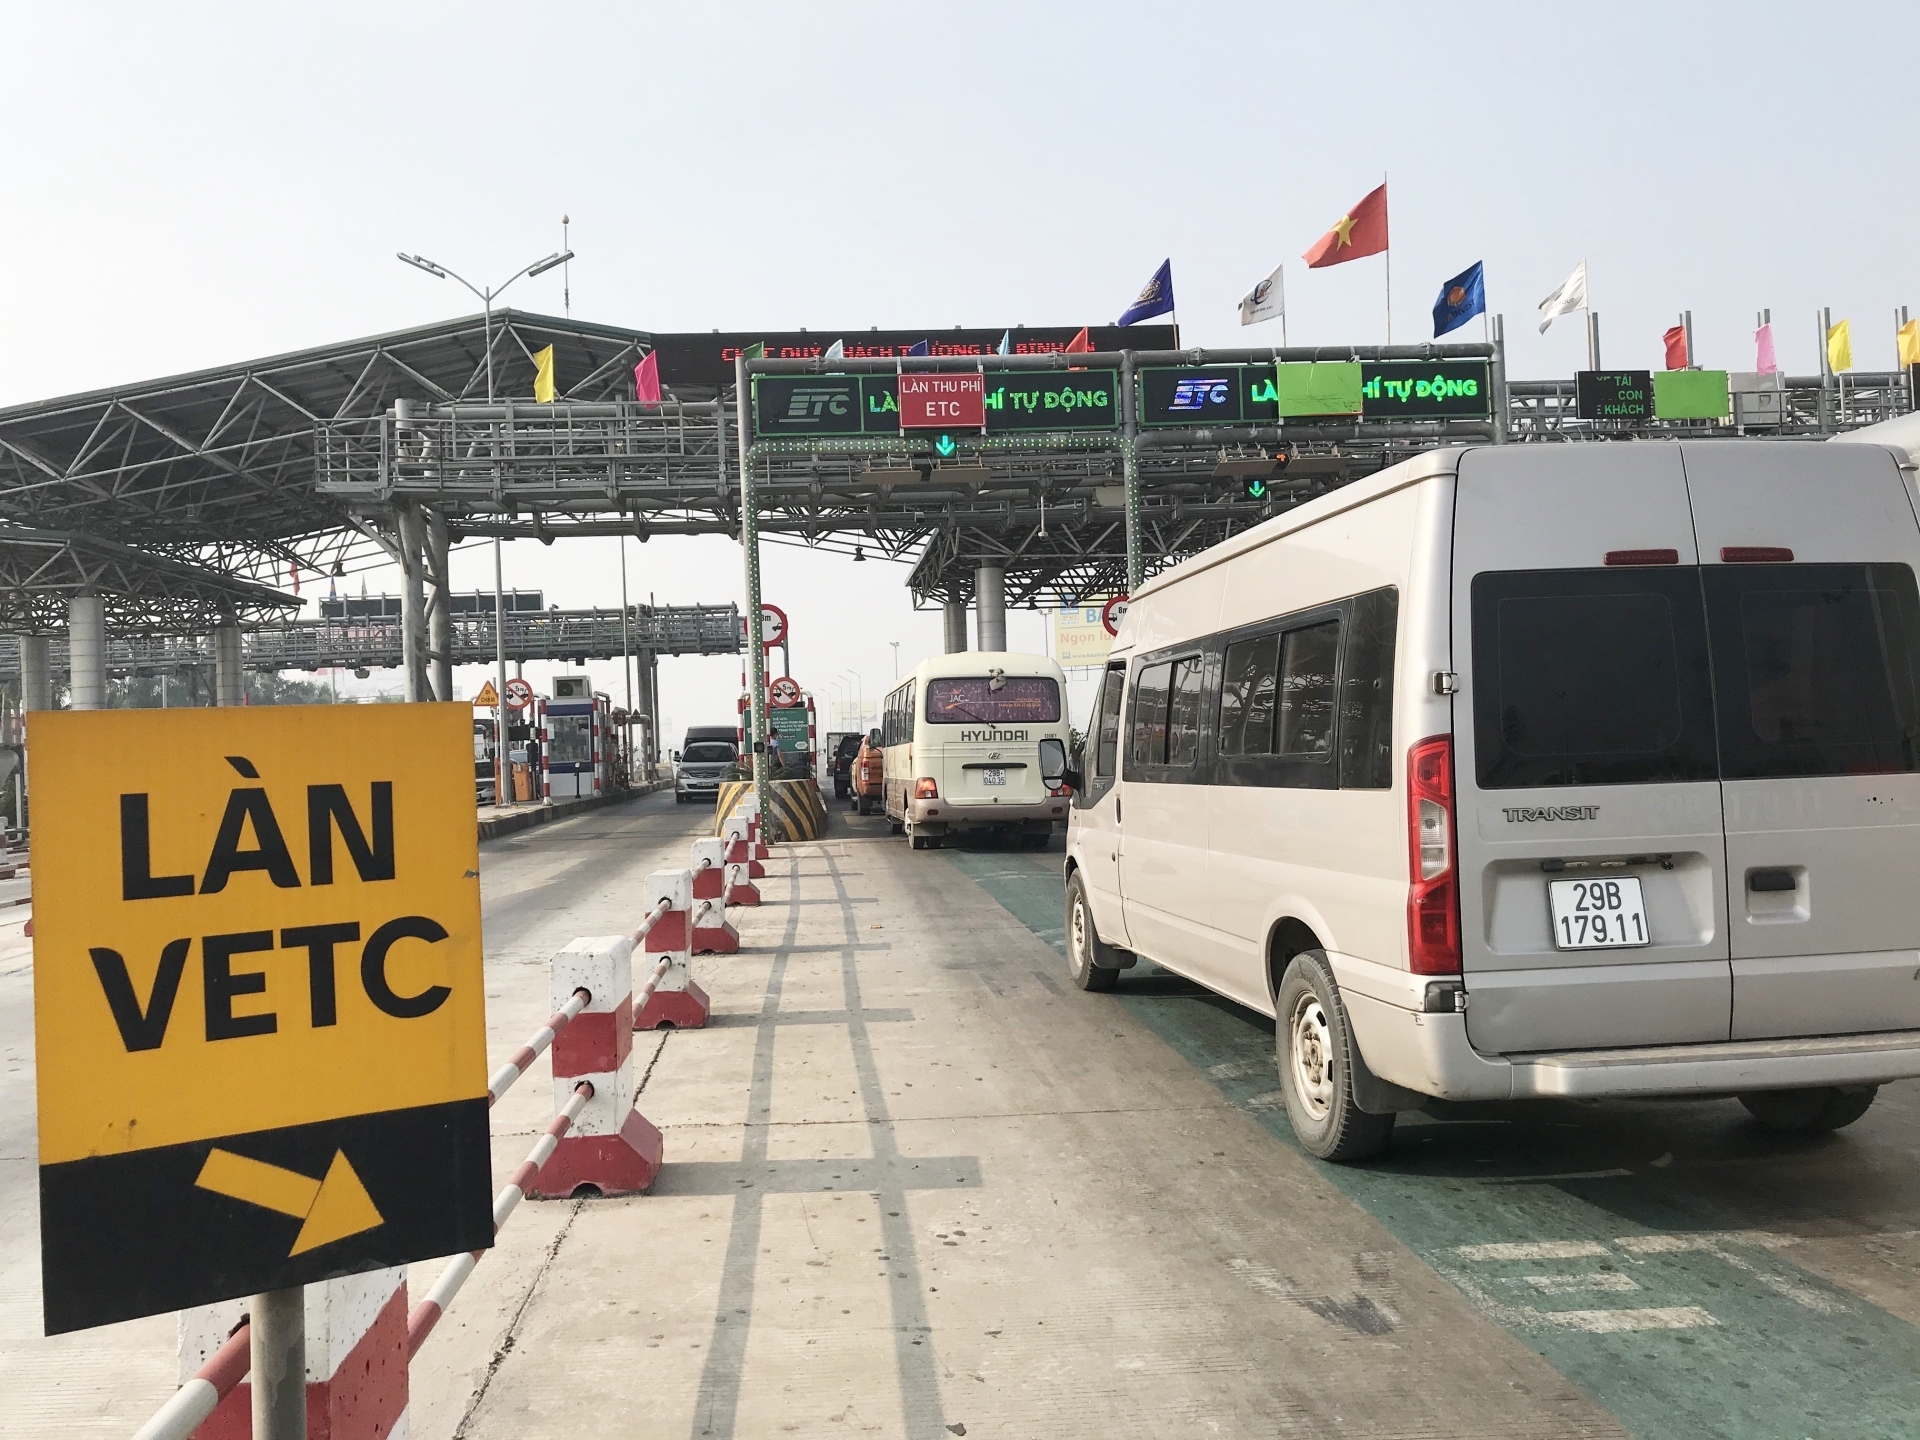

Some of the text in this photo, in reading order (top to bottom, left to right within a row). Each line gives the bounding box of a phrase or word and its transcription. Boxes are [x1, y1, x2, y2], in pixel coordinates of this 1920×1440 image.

[902, 377, 981, 394] LÀN THU PHÍ
[1173, 384, 1229, 405] ETC
[1251, 379, 1279, 402] LÀ
[1383, 378, 1414, 403] TỰ
[1415, 374, 1478, 402] ĐỘNG
[1618, 390, 1643, 401] CON
[787, 394, 850, 416] ETC
[869, 390, 899, 413] LÀ
[1010, 390, 1039, 414] TỰ
[1044, 386, 1108, 413] ĐỘNG
[926, 401, 961, 417] ETC
[1604, 402, 1644, 415] KHÁCH
[961, 730, 1029, 742] HYUNDAI
[1502, 806, 1600, 822] TRANSIT
[119, 755, 397, 901] LÀN
[1573, 881, 1623, 912] 29B
[1561, 912, 1644, 945] 179.11
[88, 915, 453, 1053] VETC
